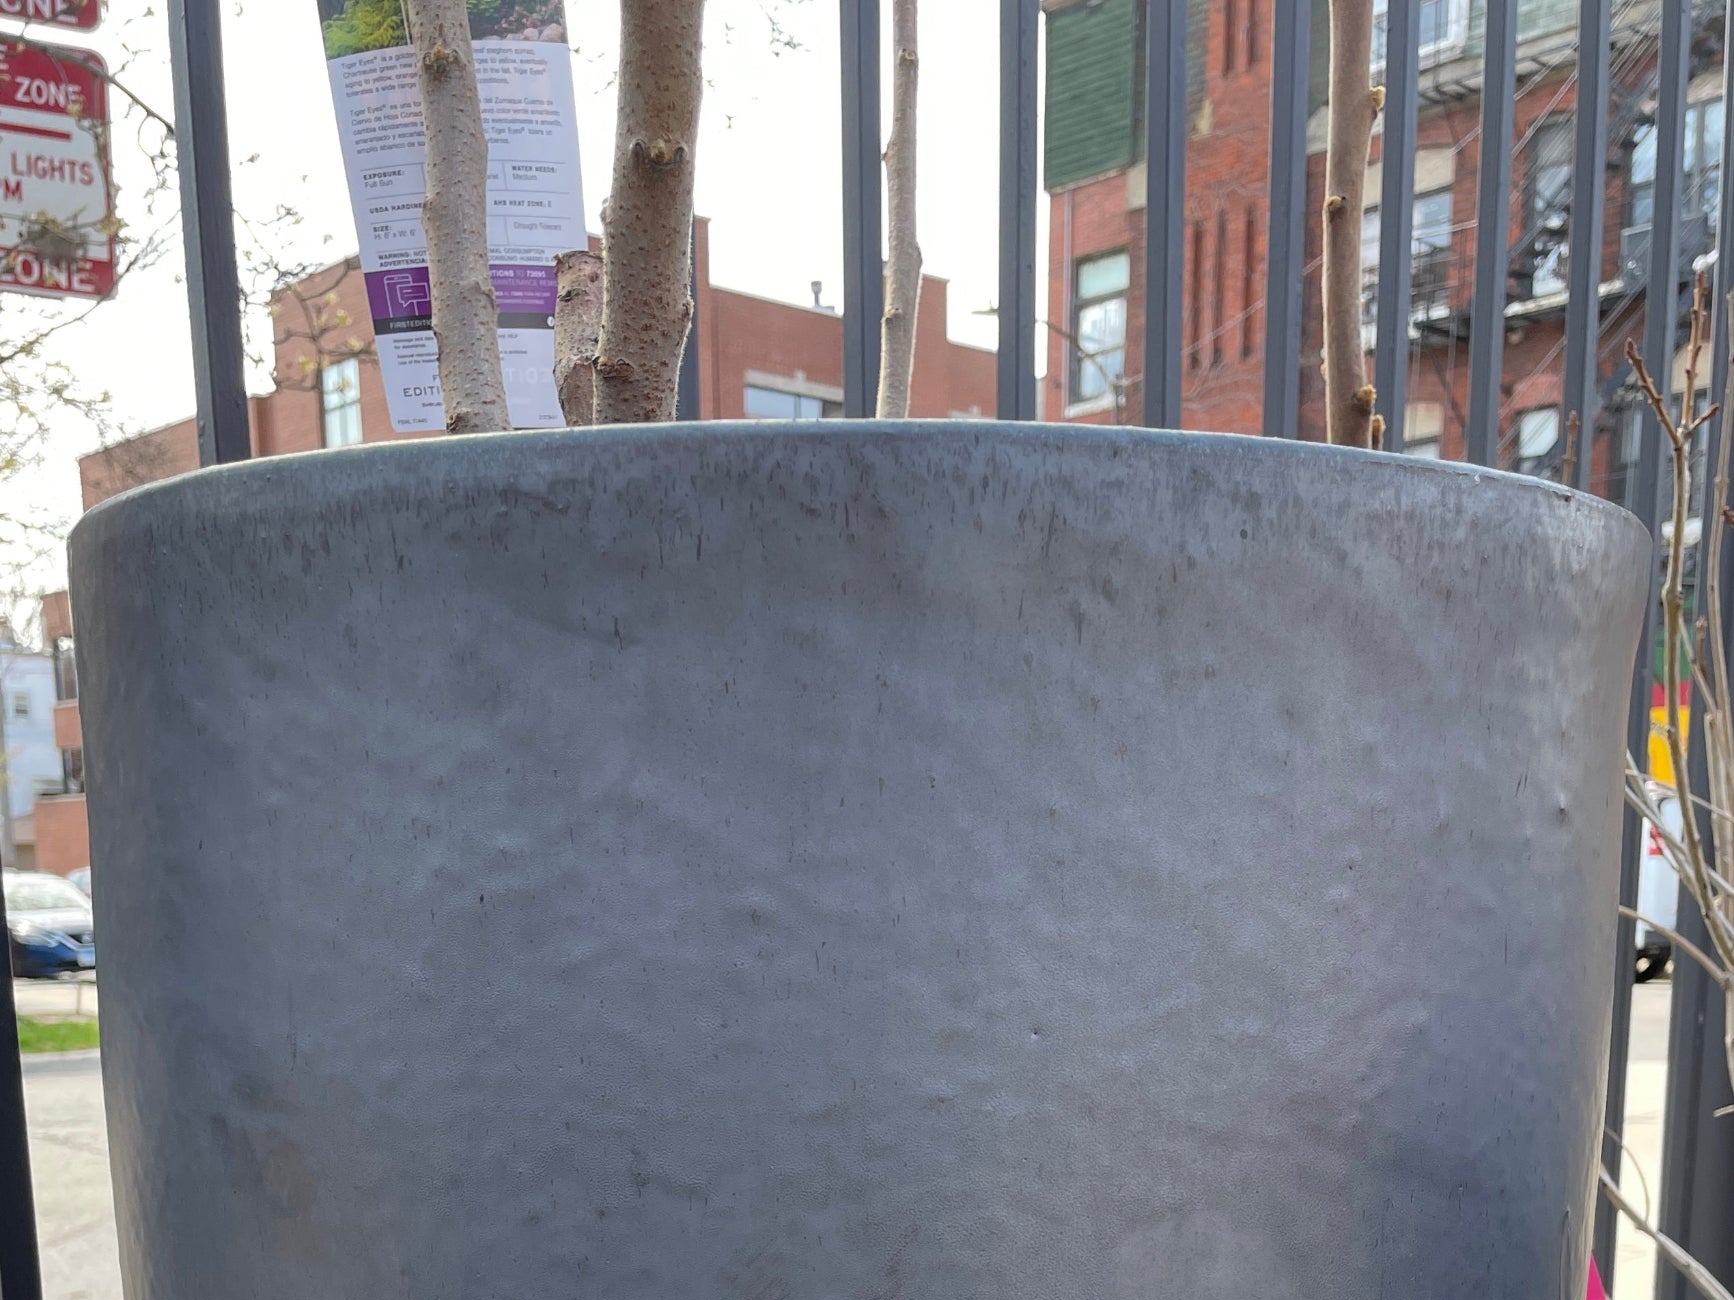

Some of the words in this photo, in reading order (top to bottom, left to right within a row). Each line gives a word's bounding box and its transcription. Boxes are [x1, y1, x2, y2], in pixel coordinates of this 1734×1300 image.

[15, 76, 82, 109] ZONE
[11, 151, 94, 187] LIGHTS
[363, 169, 405, 181] EXPOSURE:
[0, 177, 24, 203] M
[364, 180, 377, 189] Full
[369, 206, 389, 214] USDA
[372, 225, 393, 233] SIZE:
[403, 385, 440, 397] EDITI
